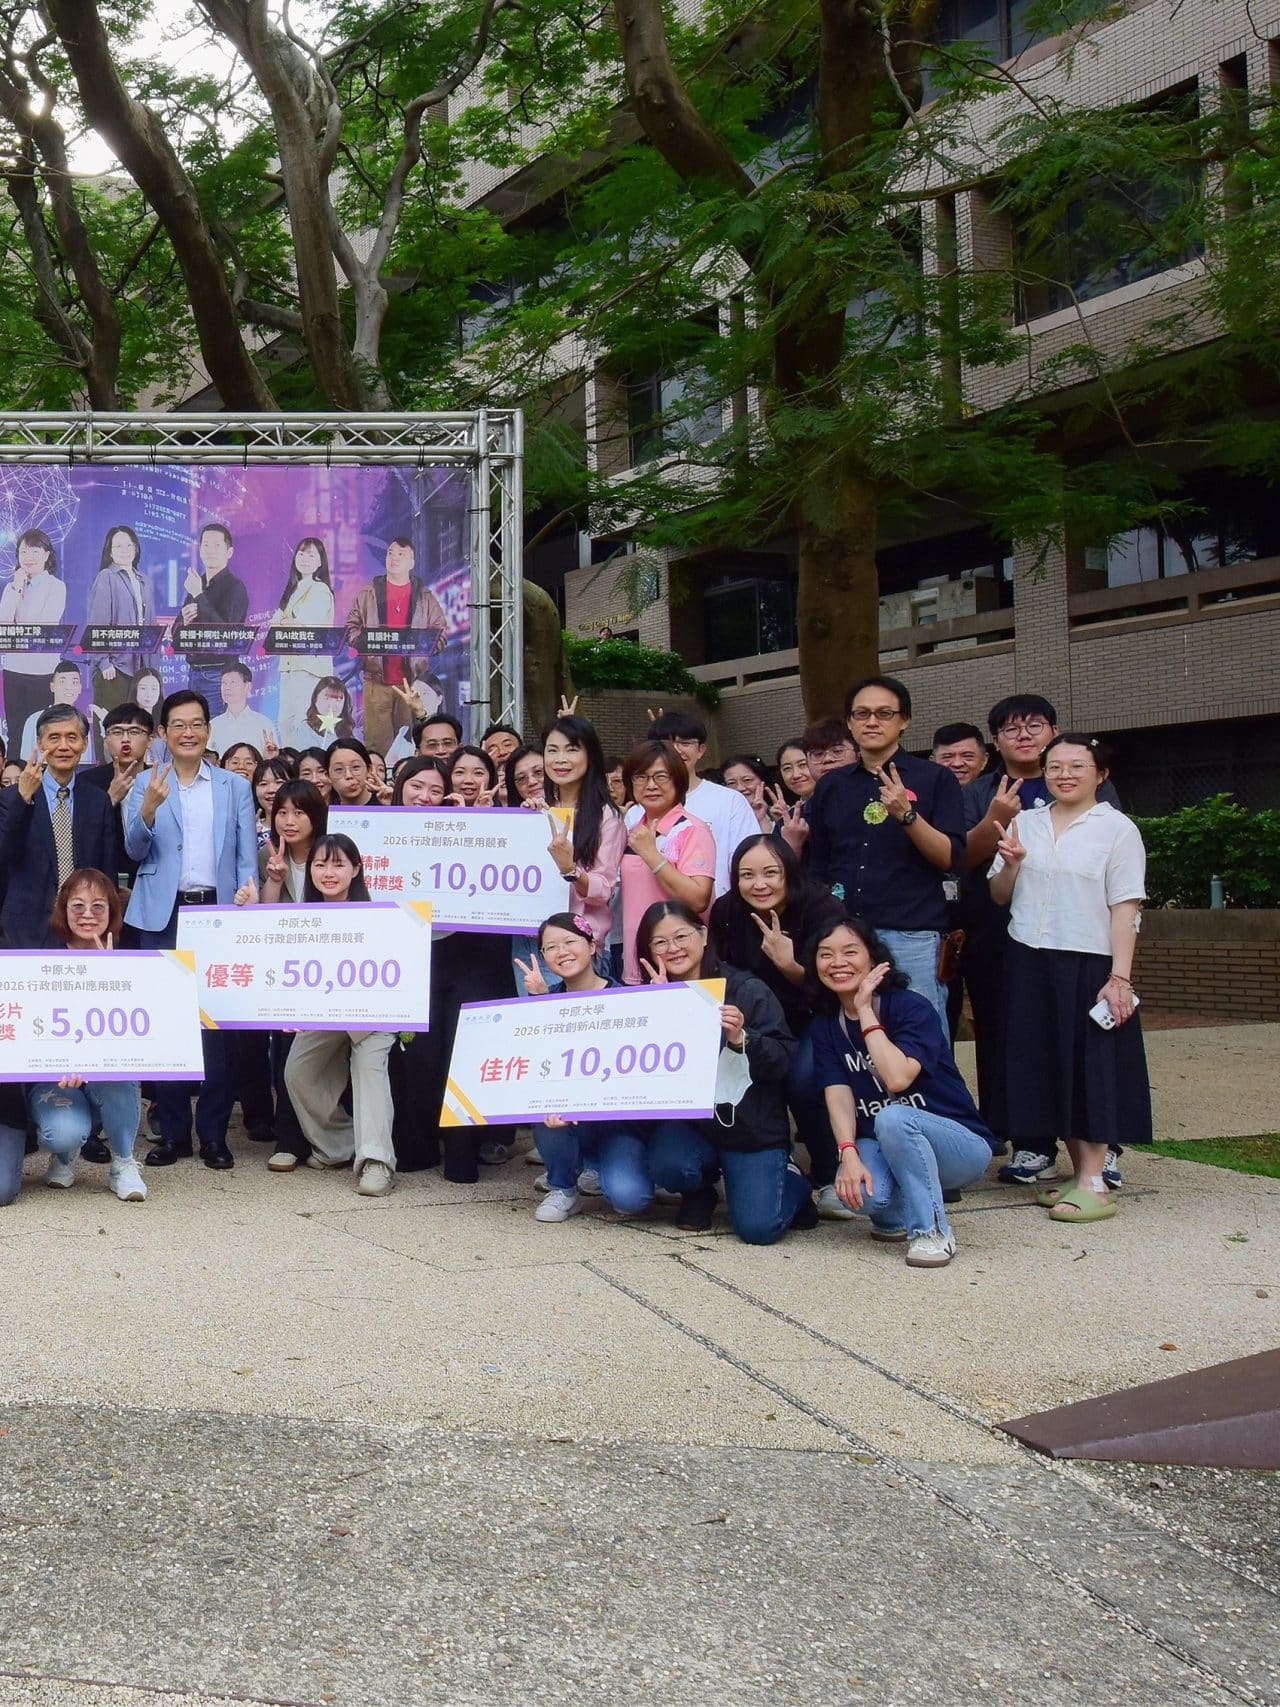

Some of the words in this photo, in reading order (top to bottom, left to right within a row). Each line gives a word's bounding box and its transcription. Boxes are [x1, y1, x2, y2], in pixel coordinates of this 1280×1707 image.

[424, 821, 467, 832] 中原大學
[383, 836, 408, 845] 2026
[410, 836, 508, 848] 行政創新AI應用競賽
[278, 917, 322, 928] 中原大學
[235, 934, 261, 944] 2026
[264, 932, 365, 944] 行政創新AI應用競賽
[41, 964, 88, 975] 中原大學
[205, 963, 255, 988] 優等
[27, 980, 132, 992] 行政創新AI應用競賽
[559, 1004, 605, 1018] 中原大學
[514, 1025, 540, 1036] 2026
[543, 1016, 648, 1035] 行政創新AI應用競賽
[480, 1056, 530, 1082] 佳作
